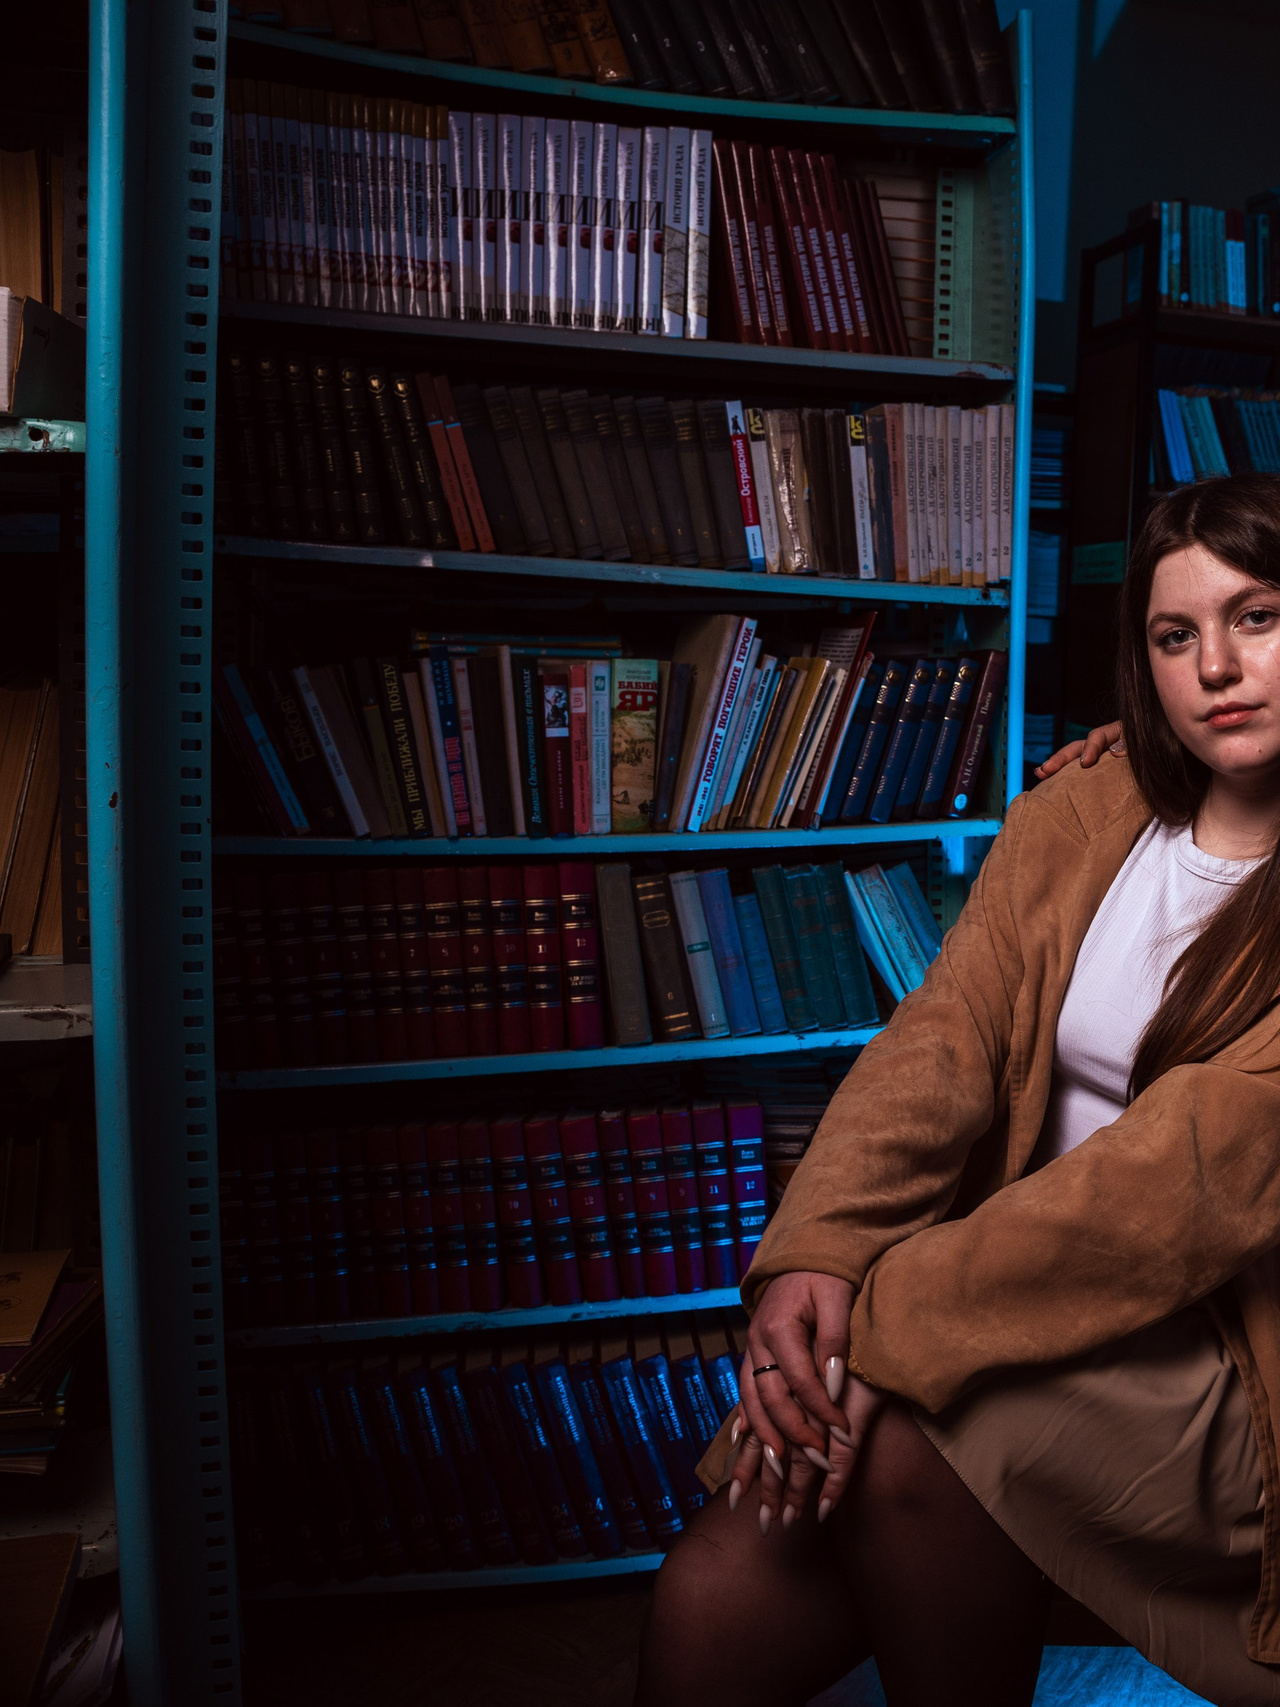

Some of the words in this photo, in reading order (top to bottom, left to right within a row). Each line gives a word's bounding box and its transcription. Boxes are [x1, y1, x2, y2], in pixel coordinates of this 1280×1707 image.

[675, 144, 684, 176] УРАЛА
[673, 178, 681, 224] ИСТОРИЯ
[731, 438, 753, 497] Островский
[381, 661, 403, 712] ПОБЕДУ
[617, 691, 657, 711] ЯР
[618, 681, 658, 690] БАБИЙ
[701, 731, 724, 783] ГОВОРЯТ
[716, 666, 742, 730] ПОГИБШИЕ
[737, 626, 754, 662] ГЕРОИ
[965, 723, 986, 766] Островский
[979, 690, 993, 715] Пьесы
[392, 717, 419, 803] ПРИБЛИЖАЛИ
[410, 808, 425, 830] МЫ
